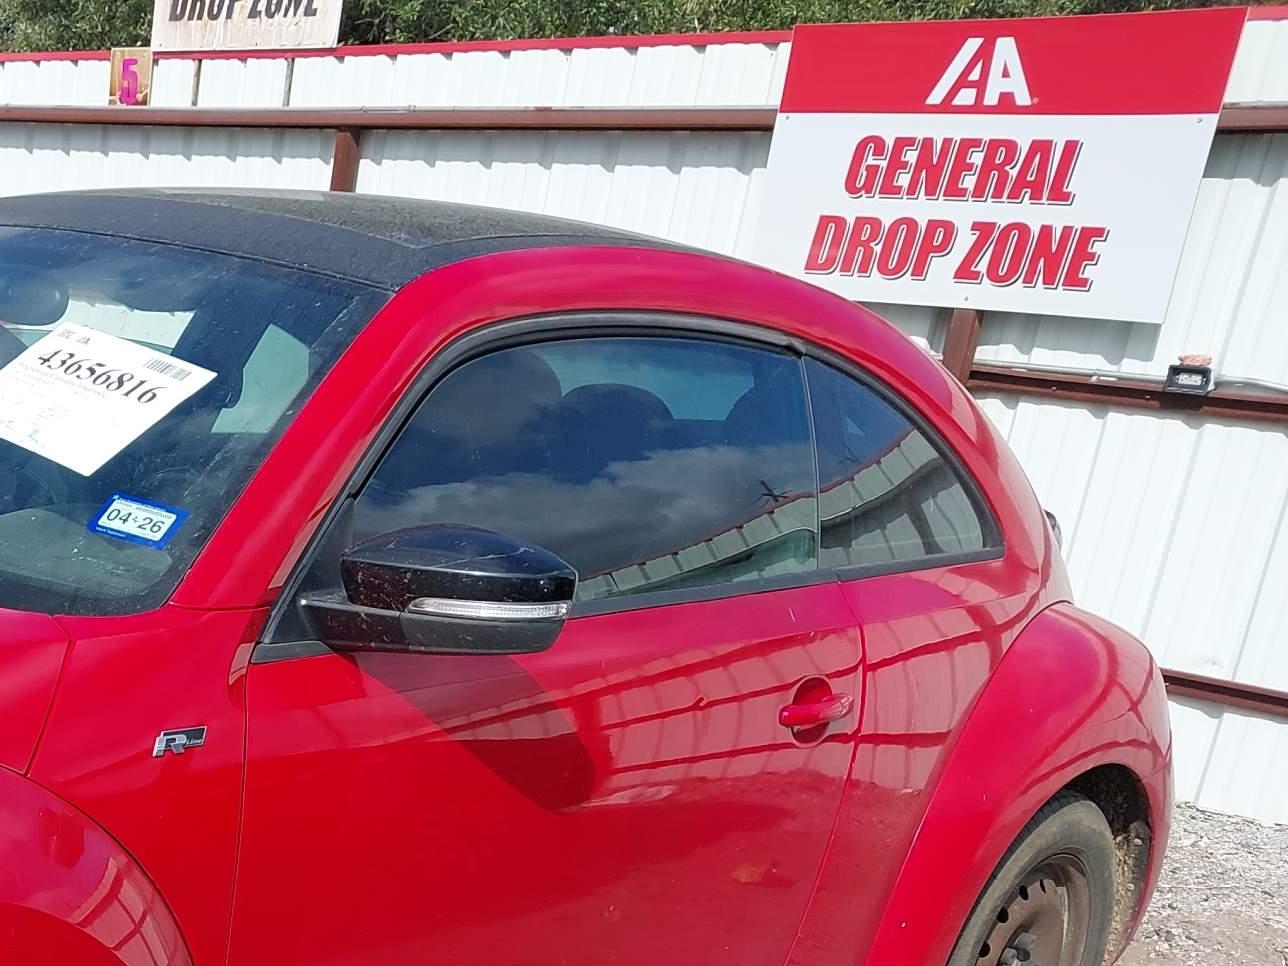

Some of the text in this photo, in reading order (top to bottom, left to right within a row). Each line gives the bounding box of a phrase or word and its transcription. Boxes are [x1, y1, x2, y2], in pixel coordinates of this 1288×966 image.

[169, 0, 319, 22] DROP ZONE
[119, 58, 139, 106] 5
[844, 135, 1084, 206] GENERAL
[803, 214, 1110, 292] DROP ZONE
[37, 349, 168, 404] 43656816
[106, 508, 132, 525] 04
[136, 516, 165, 534] 26
